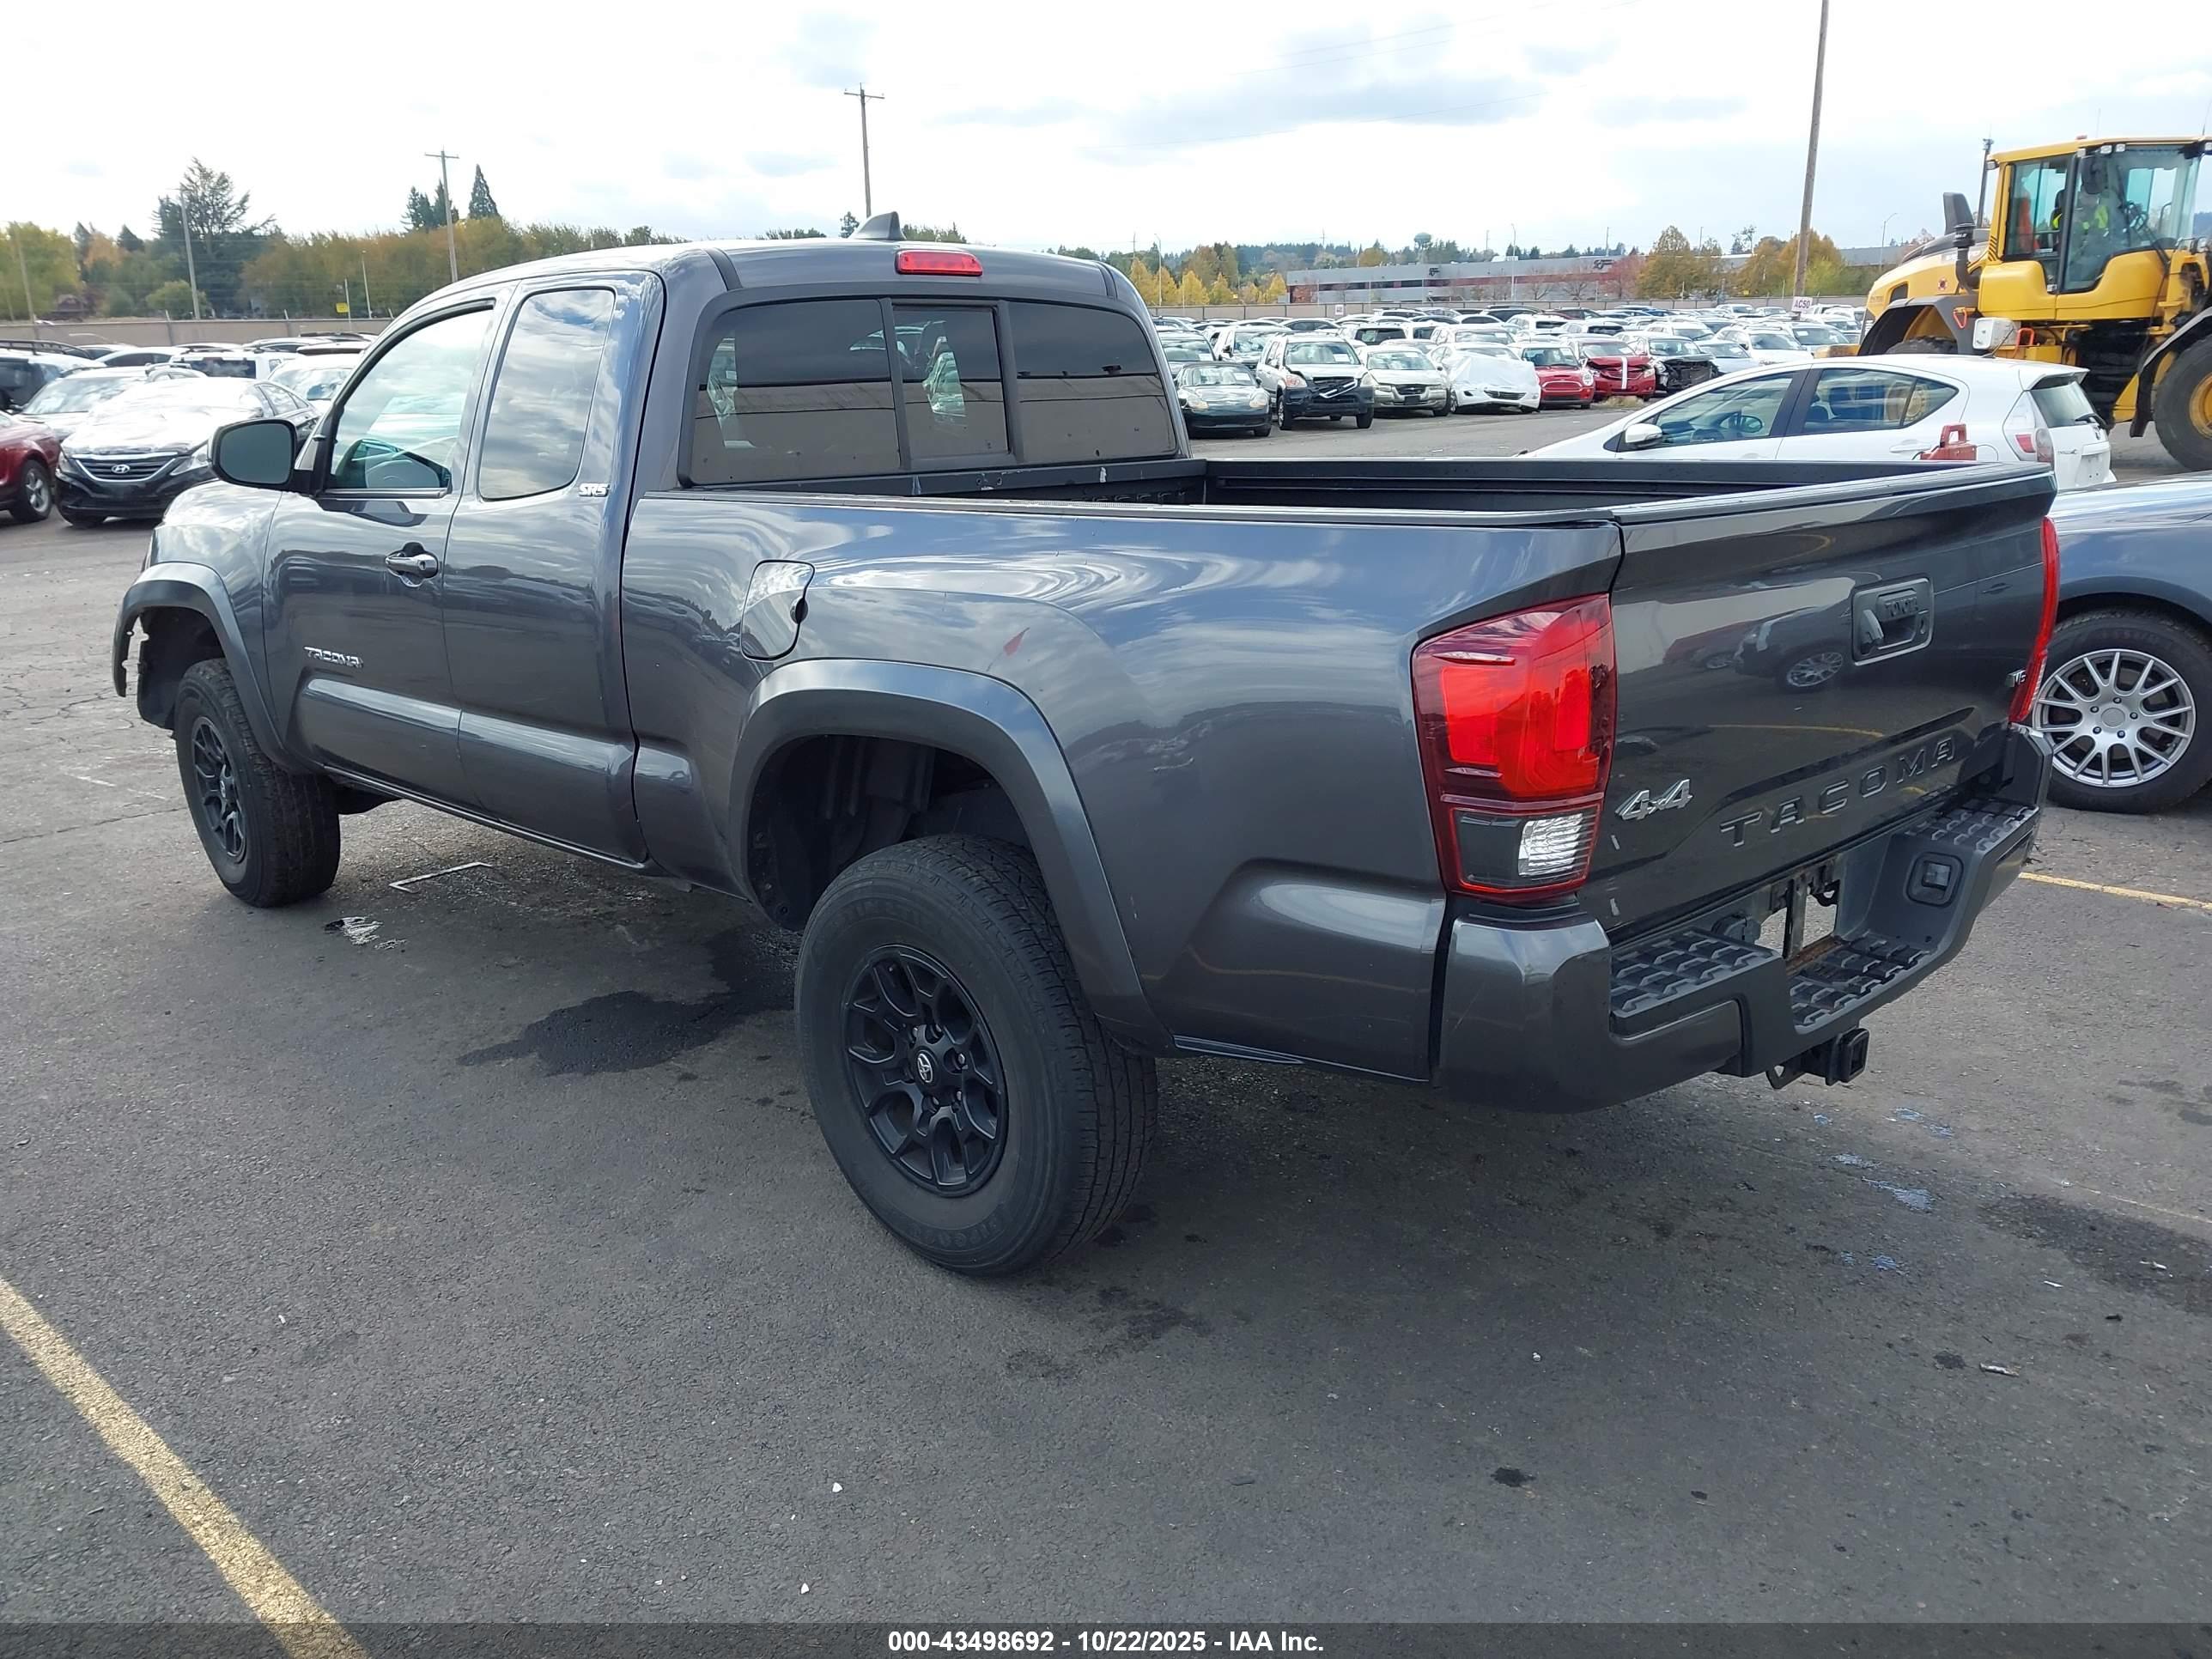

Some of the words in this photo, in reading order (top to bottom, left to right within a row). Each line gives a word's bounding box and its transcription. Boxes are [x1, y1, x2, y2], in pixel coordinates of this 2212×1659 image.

[579, 483, 610, 497] SR5
[303, 646, 364, 668] TACOMA
[1720, 737, 1955, 848] TACOMA
